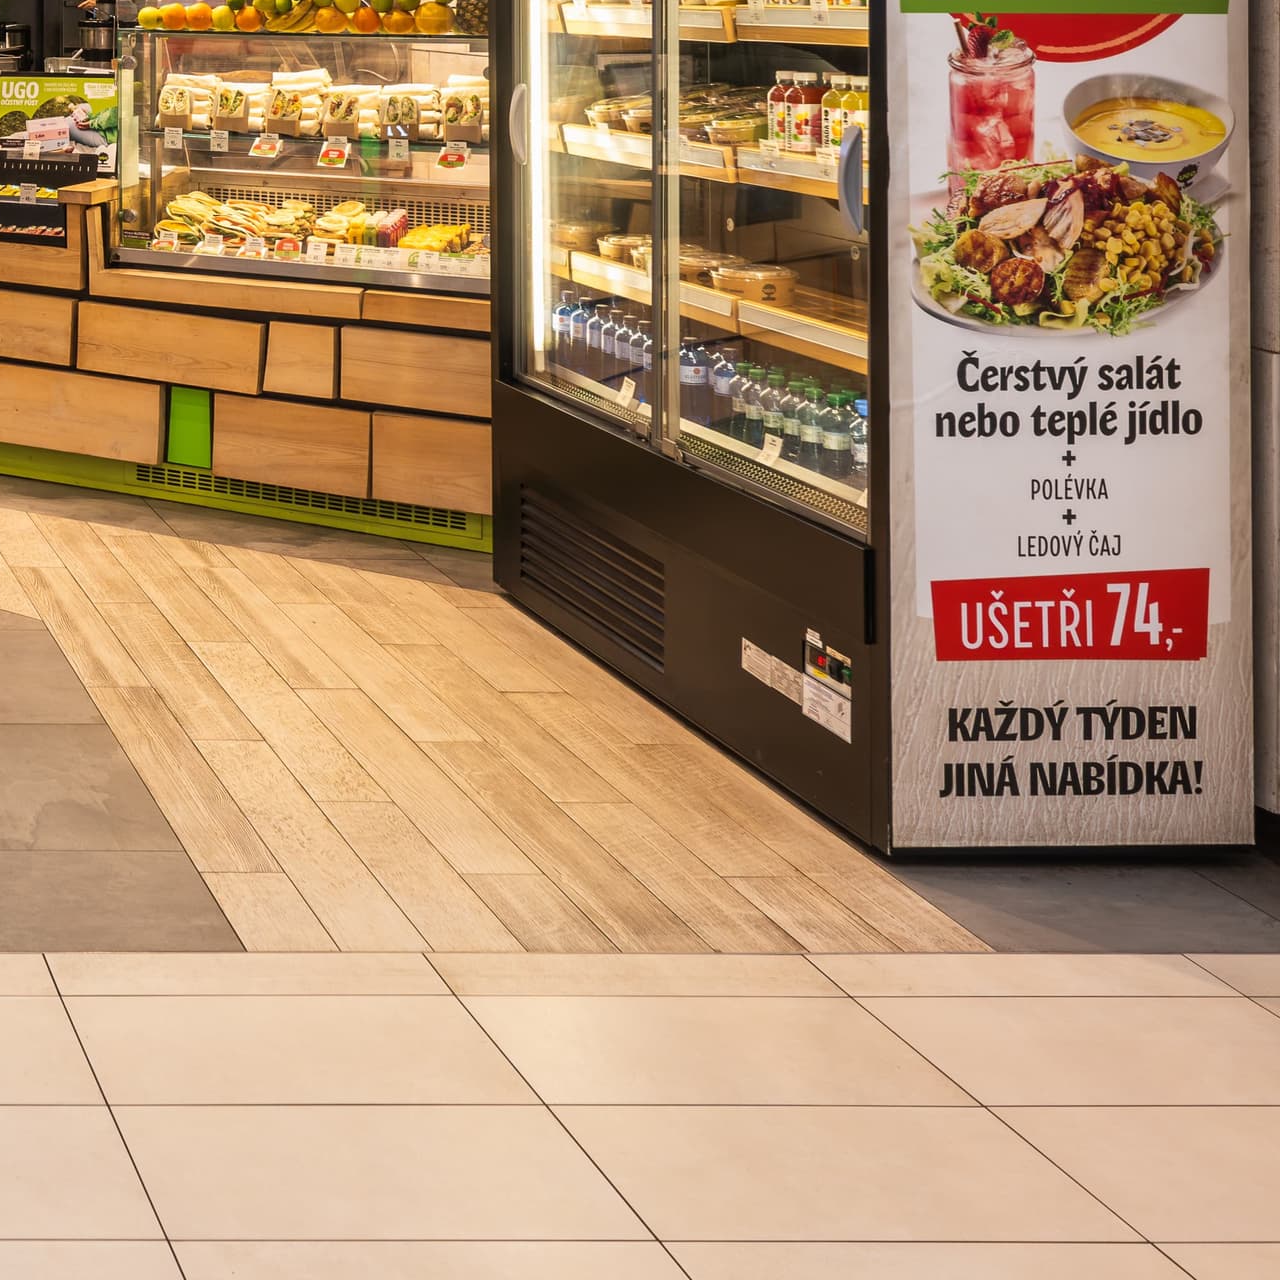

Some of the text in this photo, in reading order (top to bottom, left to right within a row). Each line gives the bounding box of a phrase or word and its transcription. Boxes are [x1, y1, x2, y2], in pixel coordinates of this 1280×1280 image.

[1, 81, 40, 99] UGO
[956, 349, 1182, 400] Čerstvý salát
[935, 399, 1204, 445] nebo teplé jídlo
[1031, 473, 1109, 501] POLÉVKA
[1017, 528, 1122, 558] LEDOVÝ ČAJ
[960, 582, 1184, 652] UŠETŘI 74,-
[947, 699, 1197, 742] KAŽDÝ TÝDEN
[939, 754, 1204, 799] JINÁ NABÍDKA!
